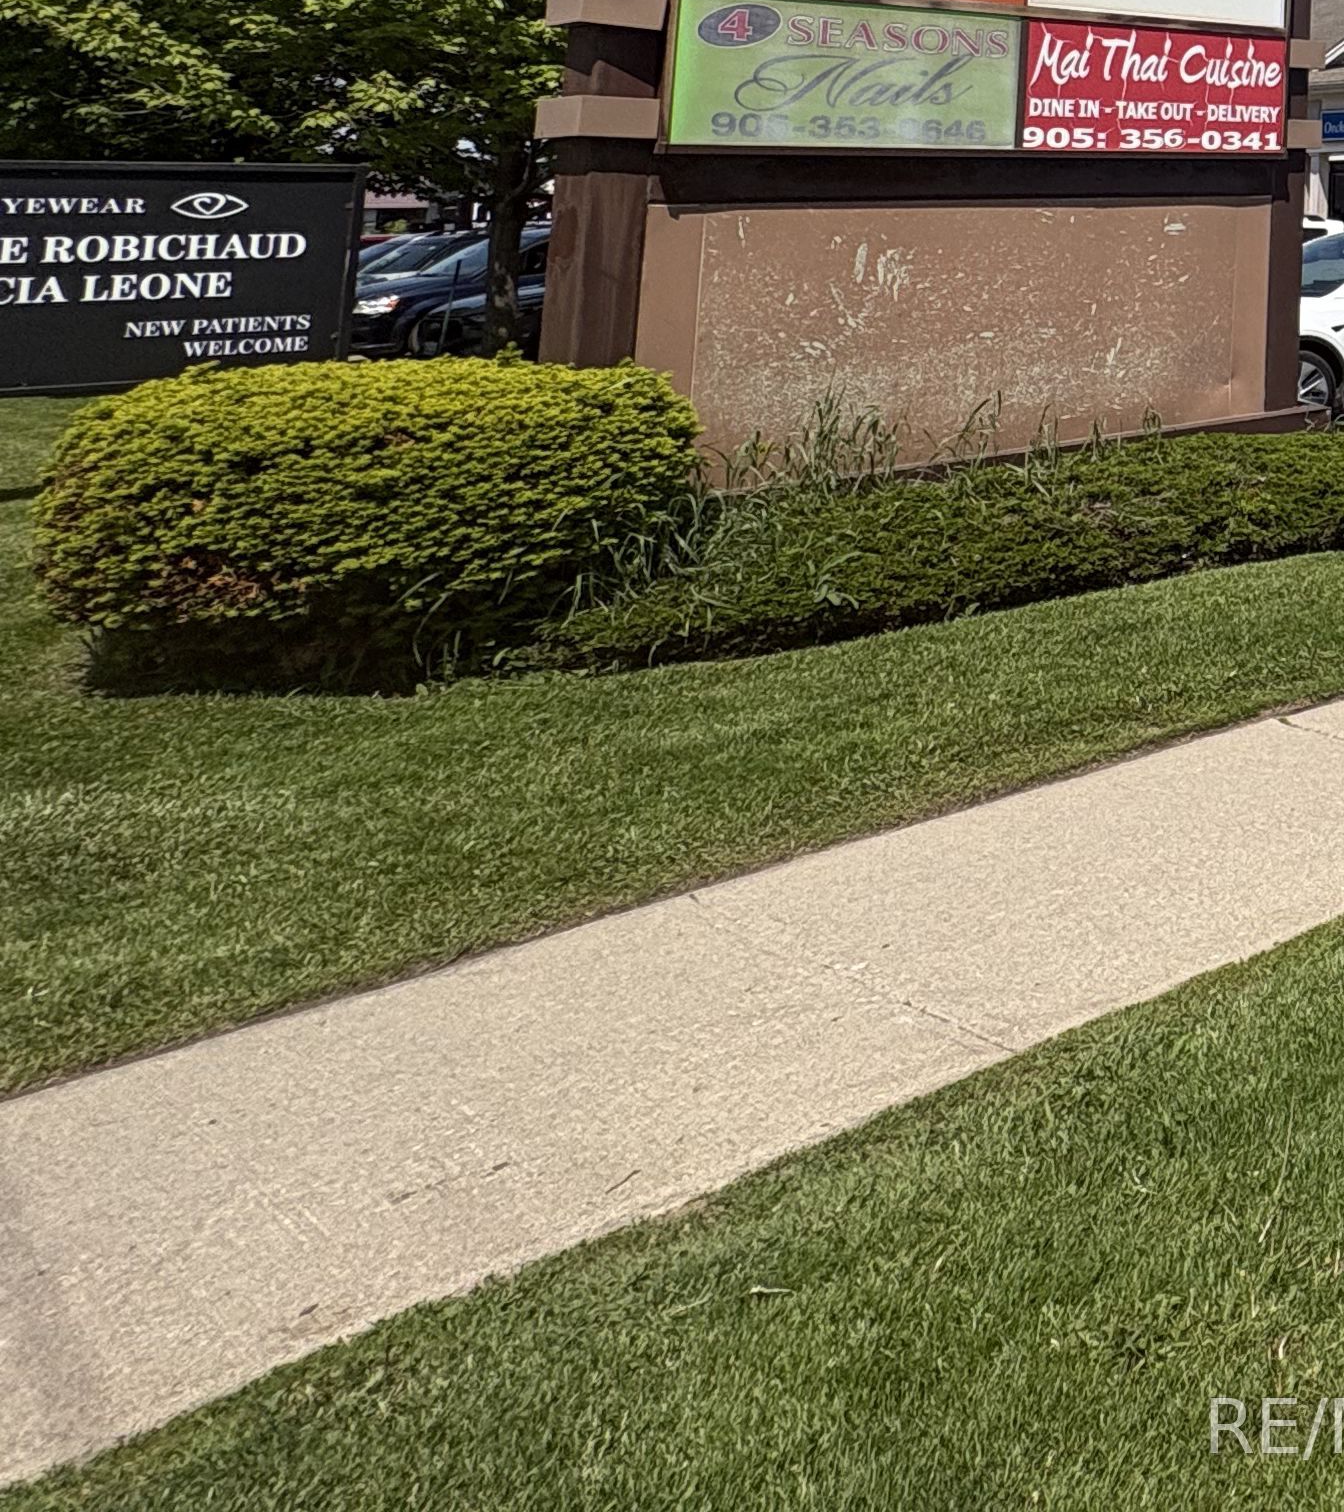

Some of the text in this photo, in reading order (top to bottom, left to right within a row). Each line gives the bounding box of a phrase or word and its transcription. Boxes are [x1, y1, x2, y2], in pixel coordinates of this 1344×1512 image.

[717, 8, 1009, 58] 4 SEASONS
[1029, 33, 1282, 89] Mai Thai Cuisine
[733, 54, 974, 112] Nails
[1029, 98, 1077, 118] DINE
[1080, 100, 1100, 118] IN
[1115, 101, 1157, 120] TAKE
[1160, 102, 1194, 121] OUT
[1207, 104, 1282, 123] DELIVERY
[1022, 128, 1282, 150] 905: 356-0341
[1, 197, 147, 214] YEWEAR
[40, 232, 308, 264] ROBICHAUD
[79, 271, 234, 303] LEONE
[124, 314, 312, 338] NEW PATIENTS
[183, 336, 310, 358] WELCOME
